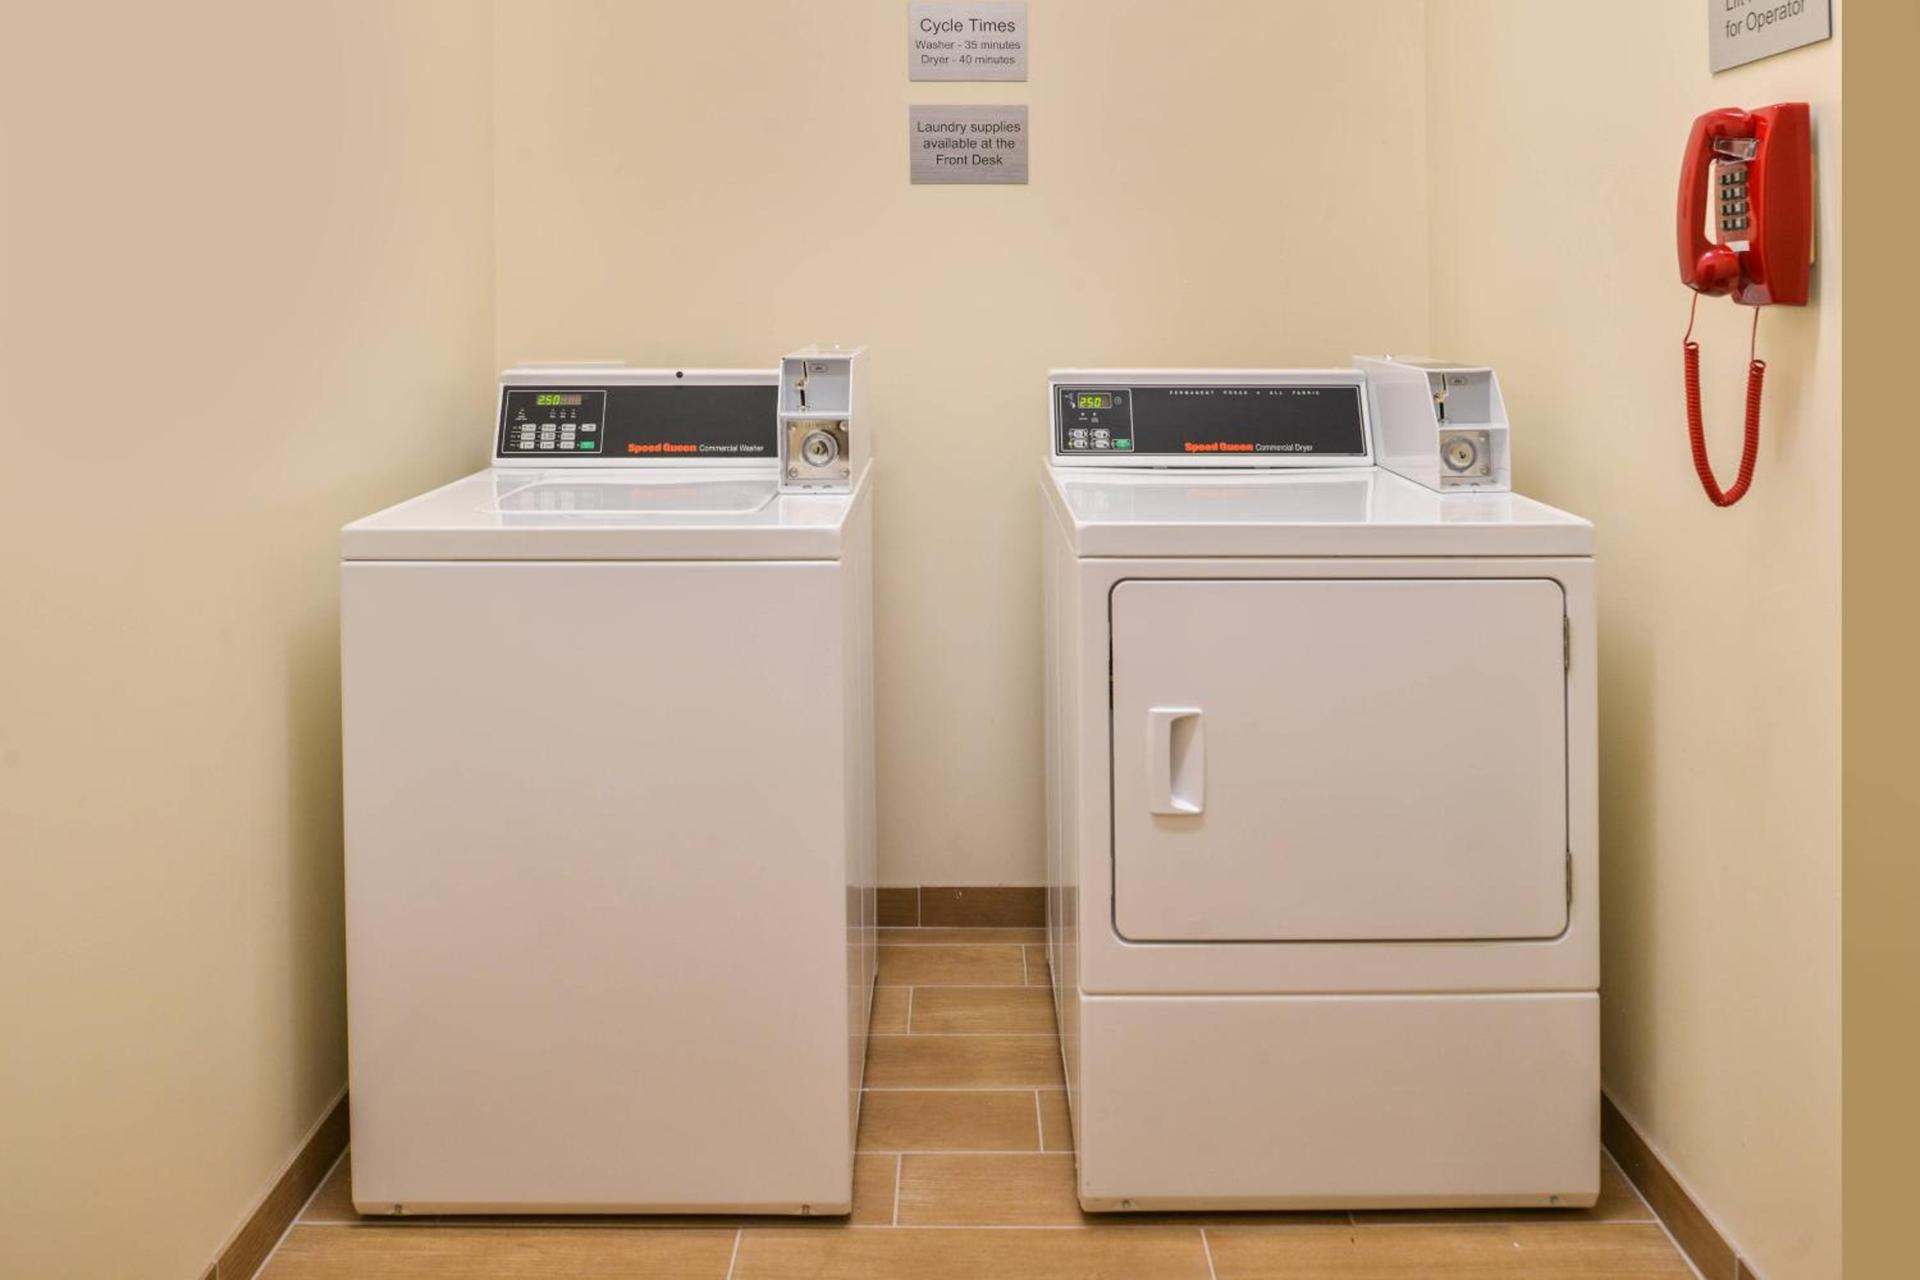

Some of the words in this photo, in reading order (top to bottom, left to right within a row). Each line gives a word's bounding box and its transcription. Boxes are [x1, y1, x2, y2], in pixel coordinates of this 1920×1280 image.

[1725, 20, 1743, 38] for
[1746, 0, 1805, 32] Operator
[920, 18, 964, 35] Cycle
[969, 18, 1016, 32] Times
[915, 40, 954, 50] Washer
[964, 40, 978, 50] 35
[980, 40, 1021, 50] minutes
[921, 55, 949, 67] Dryer
[959, 55, 973, 65] 40
[975, 55, 1016, 65] minutes
[917, 121, 967, 135] Laundry
[970, 121, 1021, 136] supplies
[923, 138, 977, 149] available
[981, 139, 993, 149] at
[996, 138, 1016, 149] the
[936, 154, 968, 165] Front
[972, 154, 1003, 165] Desk
[628, 443, 661, 454] Speed
[662, 443, 697, 453] Queen
[698, 444, 738, 452] Commercial
[740, 444, 764, 452] Washer
[1184, 442, 1218, 454] Speed
[1219, 442, 1254, 452] Queen
[1255, 443, 1294, 452] Commercial
[1295, 443, 1313, 453] Dryer
